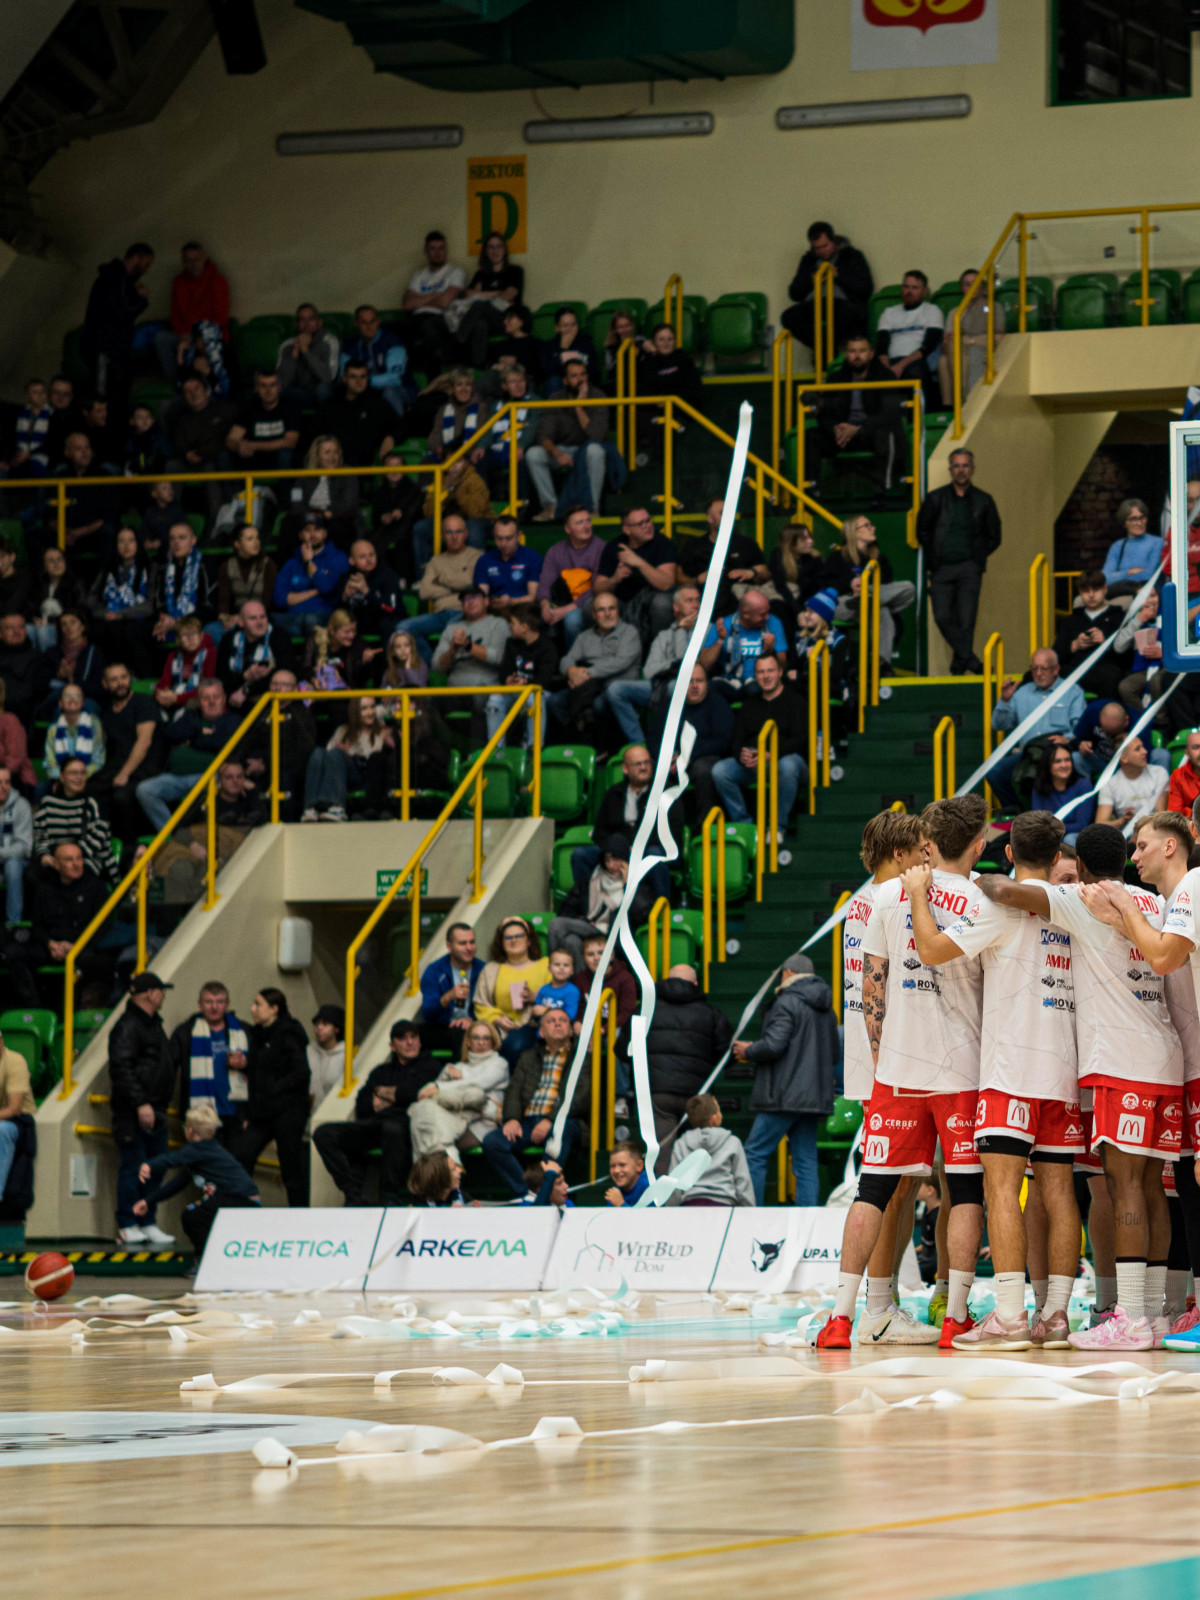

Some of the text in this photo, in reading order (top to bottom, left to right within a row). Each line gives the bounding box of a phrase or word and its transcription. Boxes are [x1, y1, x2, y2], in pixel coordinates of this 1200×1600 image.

[469, 162, 524, 179] SEKTOR
[475, 190, 519, 244] D
[223, 1240, 350, 1258] QEMETICA
[396, 1239, 527, 1257] ARKEMA
